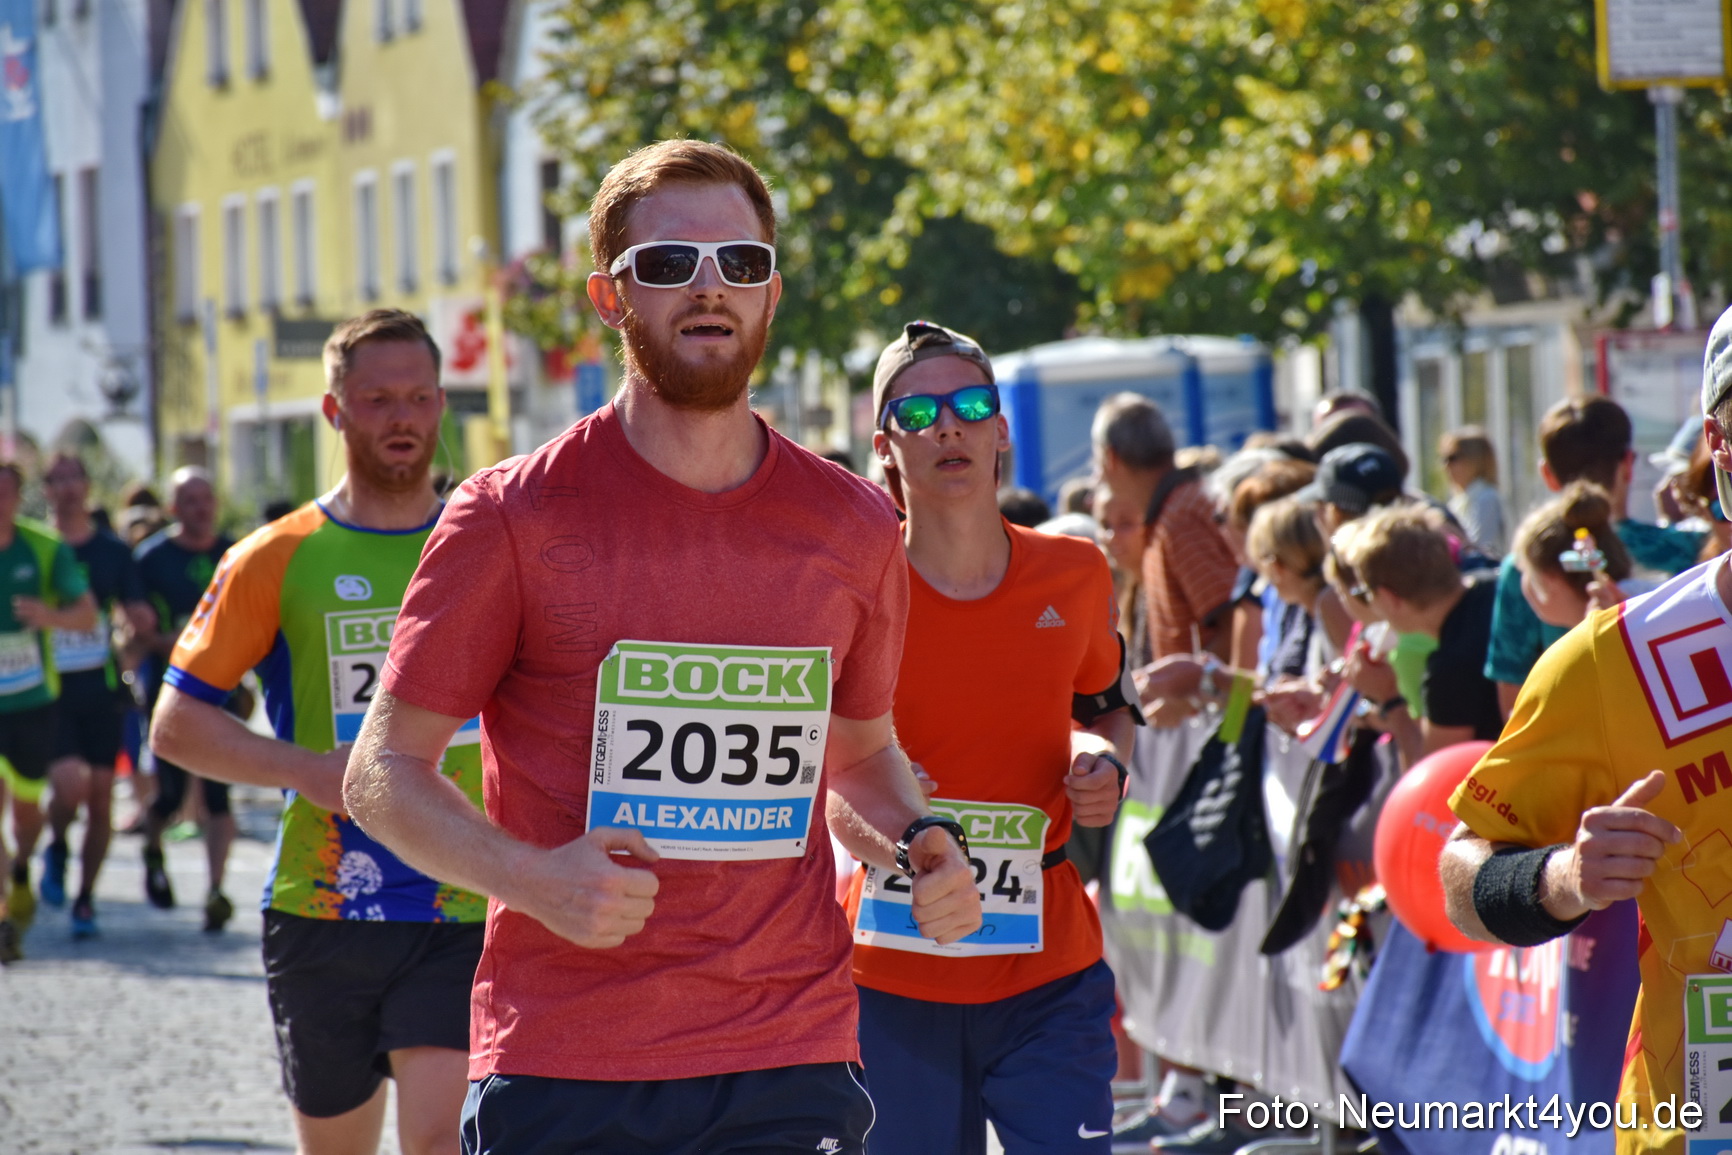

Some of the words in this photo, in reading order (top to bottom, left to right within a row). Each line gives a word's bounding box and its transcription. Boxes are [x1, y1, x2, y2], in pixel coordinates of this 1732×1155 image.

[1035, 619, 1066, 629] adidas
[620, 653, 814, 702] BOCK
[621, 719, 803, 786] 2035
[612, 802, 793, 830] ALEXANDER
[1463, 772, 1519, 826] egl.de
[820, 1137, 839, 1150] NIKE
